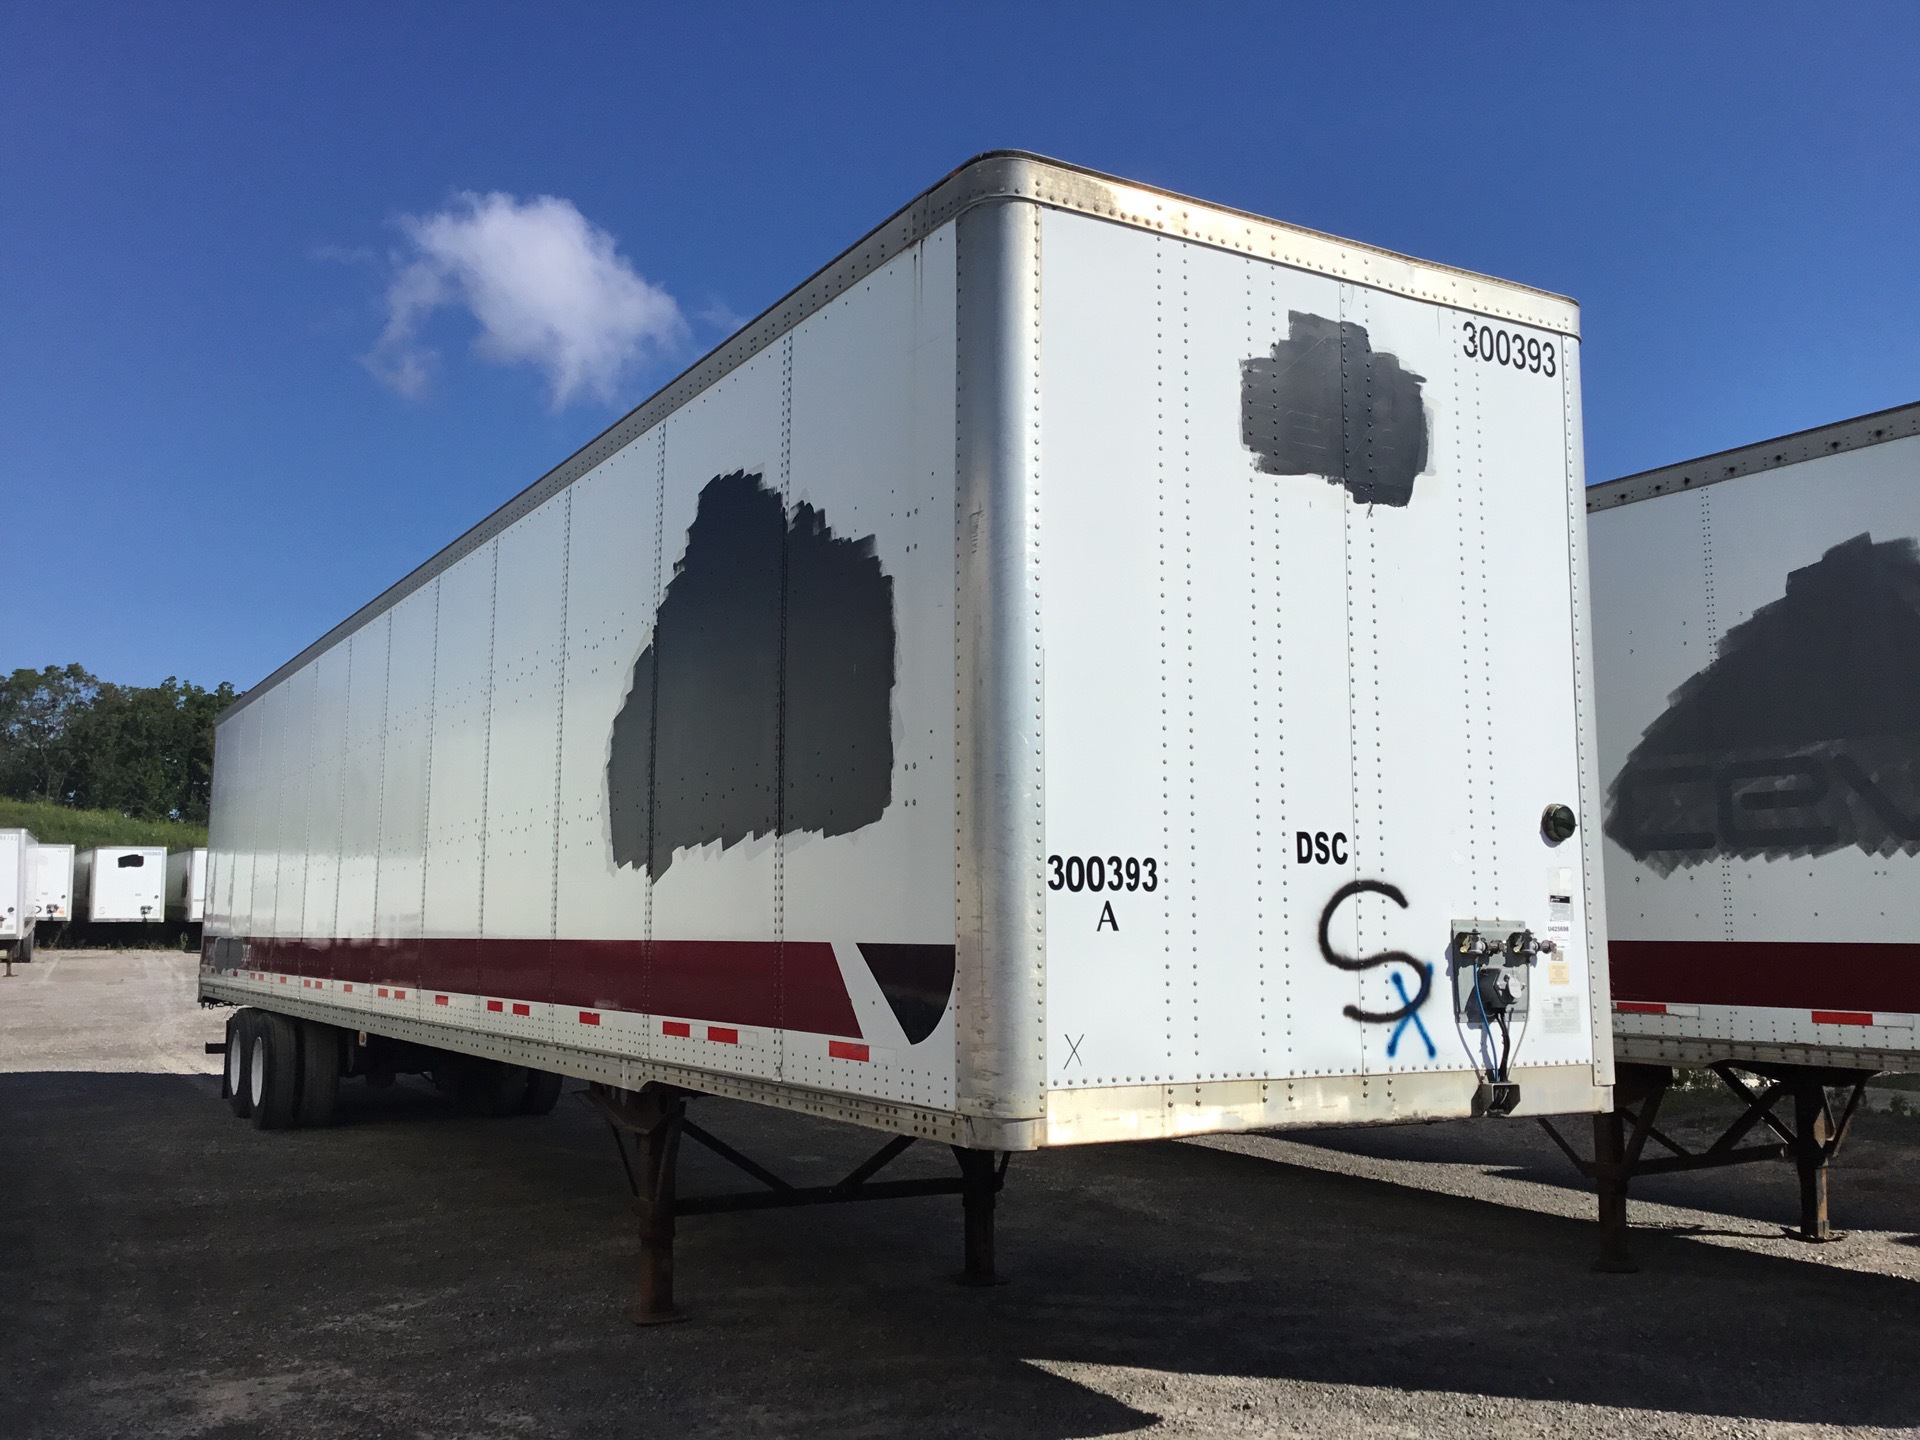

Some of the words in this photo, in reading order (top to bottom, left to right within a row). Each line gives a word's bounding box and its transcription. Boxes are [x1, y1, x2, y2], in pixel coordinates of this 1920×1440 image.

[1462, 321, 1557, 378] 300393
[1296, 831, 1349, 865] DSC
[1047, 855, 1158, 892] 300393
[1096, 900, 1120, 932] A
[1317, 879, 1433, 1024] S
[1386, 960, 1437, 1059] X
